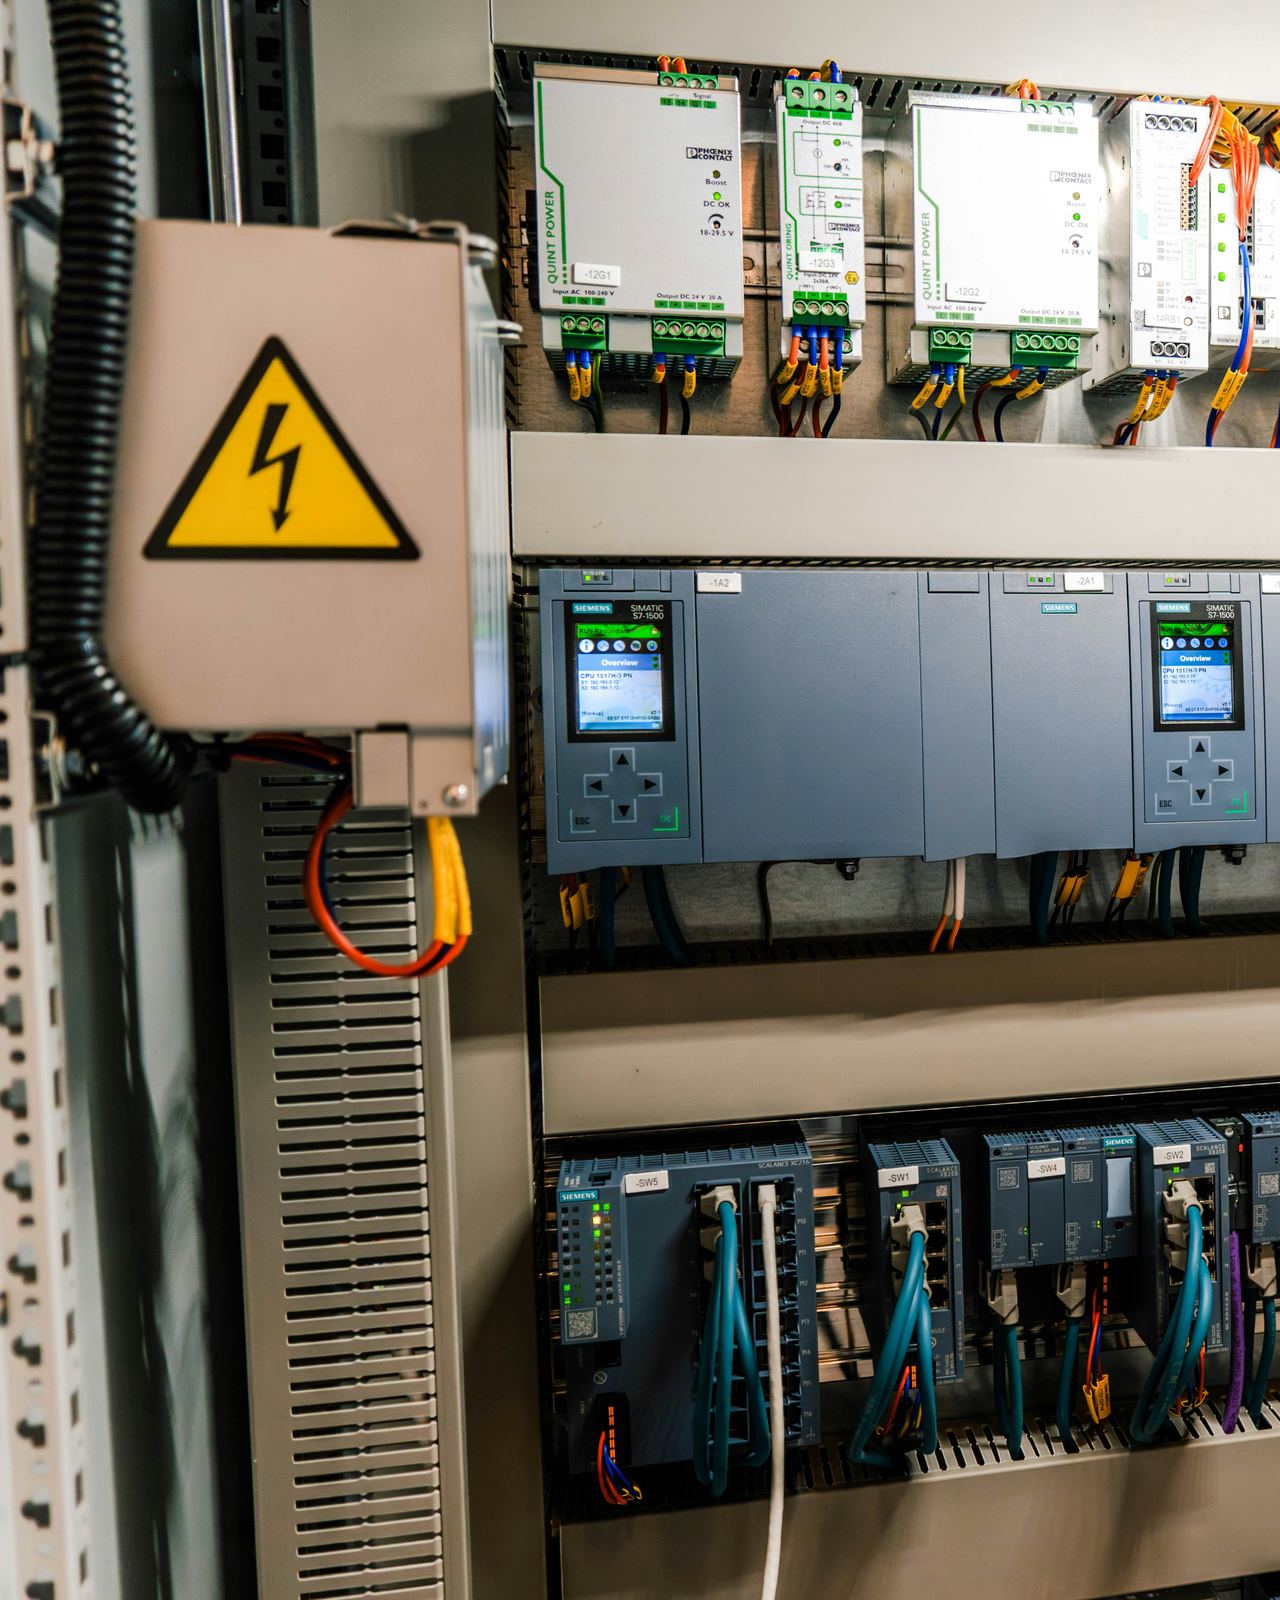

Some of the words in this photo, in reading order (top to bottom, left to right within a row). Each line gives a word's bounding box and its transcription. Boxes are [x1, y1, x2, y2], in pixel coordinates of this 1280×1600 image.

[705, 178, 727, 186] Boost
[545, 191, 555, 238] POWER
[922, 212, 930, 256] POWER
[546, 241, 558, 284] QUINT
[809, 259, 835, 268] -12G3
[584, 270, 611, 280] -12G1
[923, 260, 932, 300] QUINT
[553, 288, 569, 296] Input
[656, 292, 679, 300] Output
[955, 288, 980, 297] -12G2
[1153, 314, 1180, 324] -14RB1
[709, 578, 730, 588] -1A2
[1077, 576, 1095, 586] -2A1
[630, 604, 664, 612] SIMATIC
[1206, 604, 1234, 612] SIMATIC
[632, 612, 664, 620] S7-1500
[575, 817, 590, 825] ESC
[660, 815, 671, 823] OK
[1105, 1138, 1133, 1146] SIEMENS
[1196, 1144, 1225, 1152] SCALANCE
[1163, 1151, 1184, 1160] -SW2
[1036, 1164, 1057, 1174] -SW4
[888, 1173, 909, 1182] -SW1
[635, 1178, 658, 1188] -SW5
